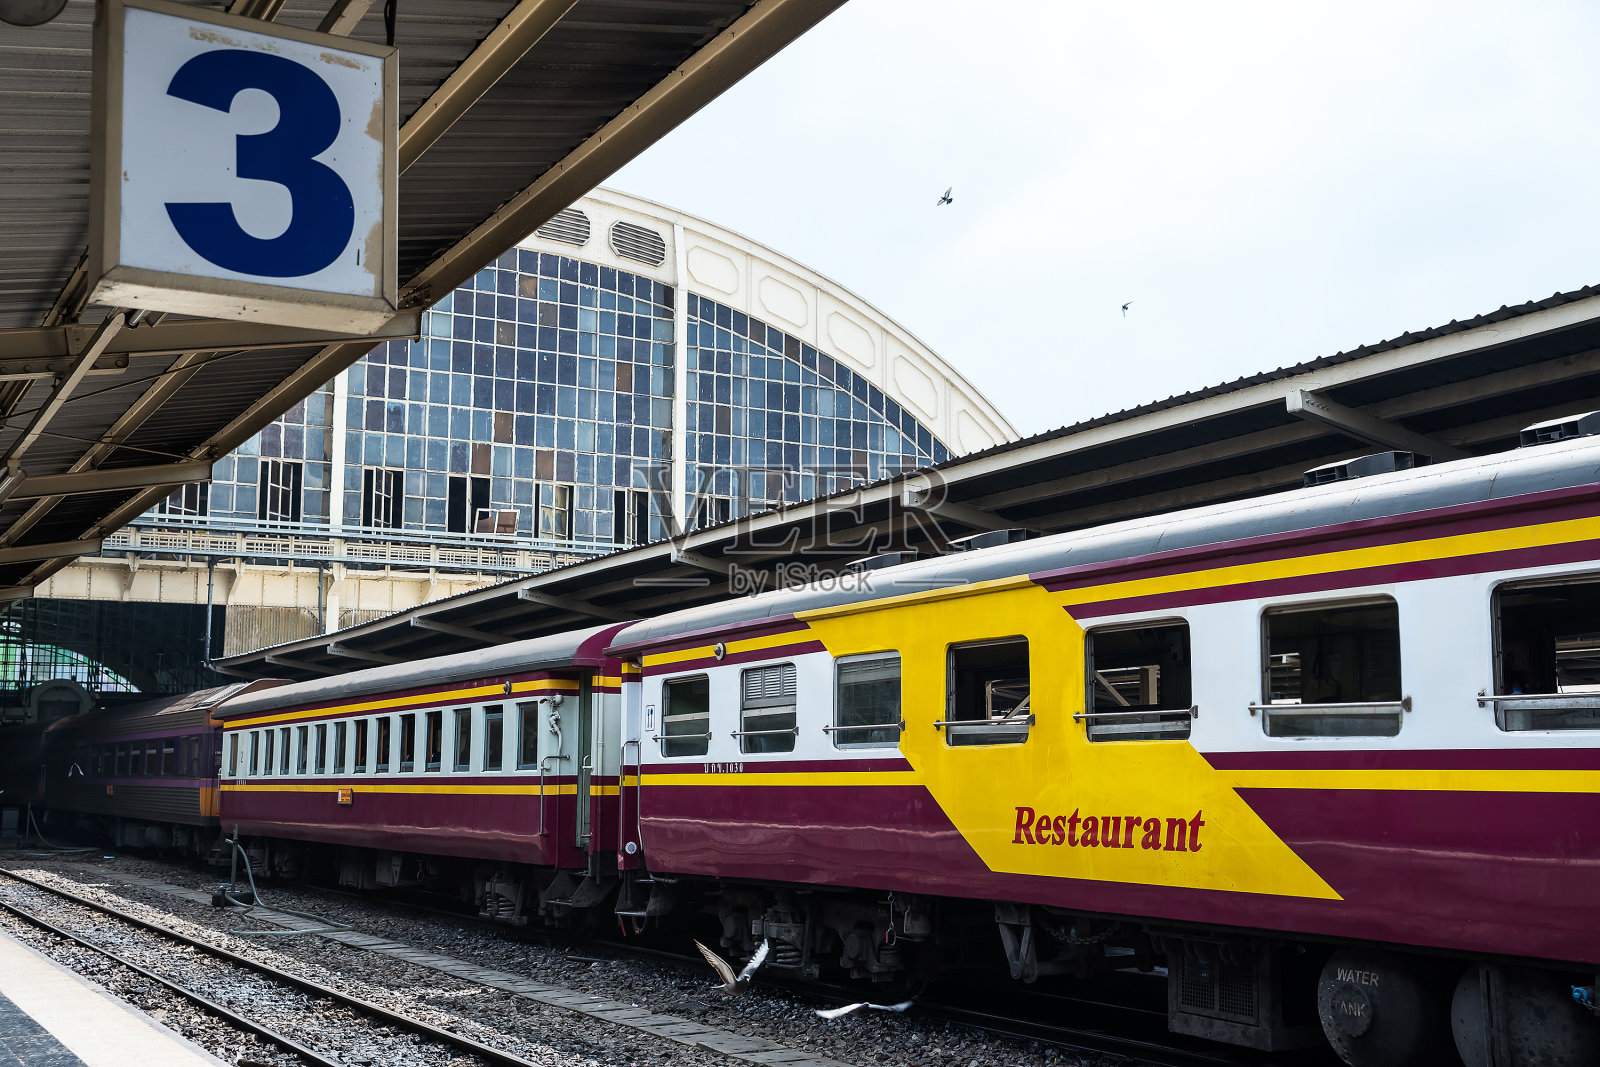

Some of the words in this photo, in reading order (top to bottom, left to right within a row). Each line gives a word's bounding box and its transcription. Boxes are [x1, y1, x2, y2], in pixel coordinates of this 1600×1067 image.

[164, 49, 355, 278] 3
[1012, 806, 1205, 852] Restaurant
[1336, 967, 1379, 986] WATER
